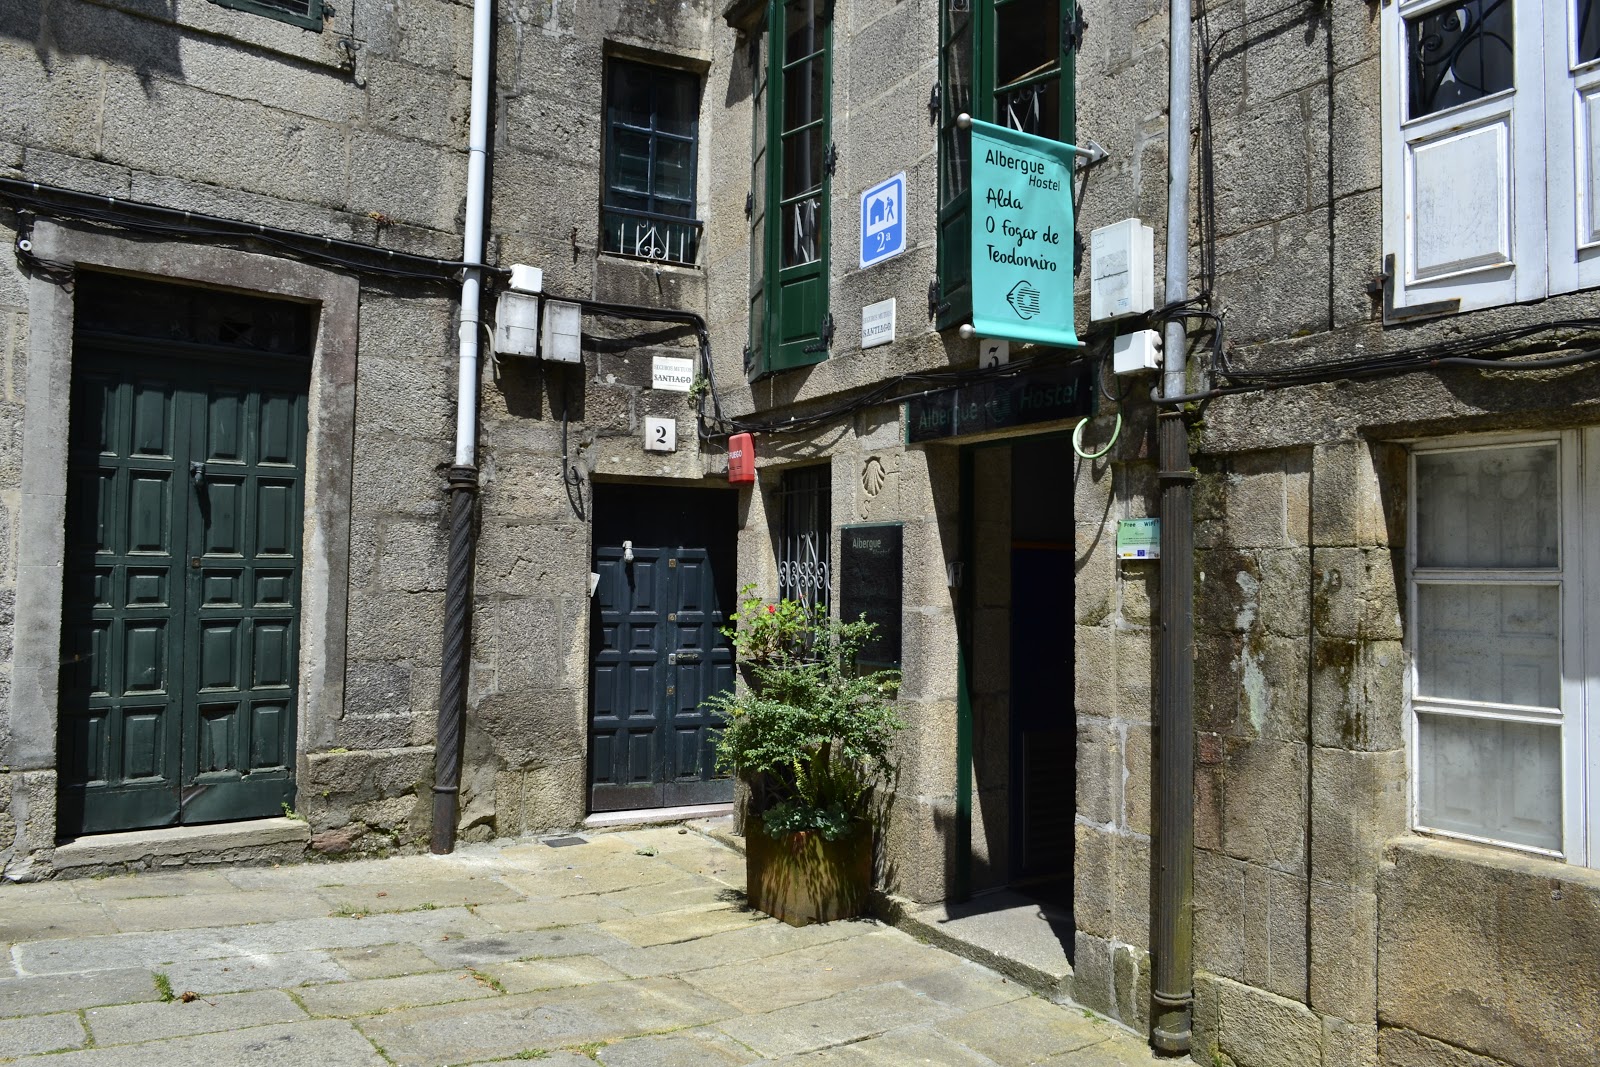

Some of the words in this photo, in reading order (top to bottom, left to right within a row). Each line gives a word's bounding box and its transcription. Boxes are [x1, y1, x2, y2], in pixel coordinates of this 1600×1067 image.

[985, 149, 1045, 175] Albergue
[1028, 174, 1061, 191] Hostel
[986, 188, 1023, 210] Alda
[985, 215, 996, 234] O
[1002, 218, 1038, 247] fogar
[1042, 225, 1060, 245] de
[986, 244, 1057, 272] Teodomiro
[862, 322, 892, 338] SANTIAGO
[987, 345, 1000, 368] 3
[654, 374, 692, 384] SANTIAGO
[1021, 377, 1079, 408] Hostel
[655, 425, 667, 444] 2
[852, 537, 882, 551] Albergue
